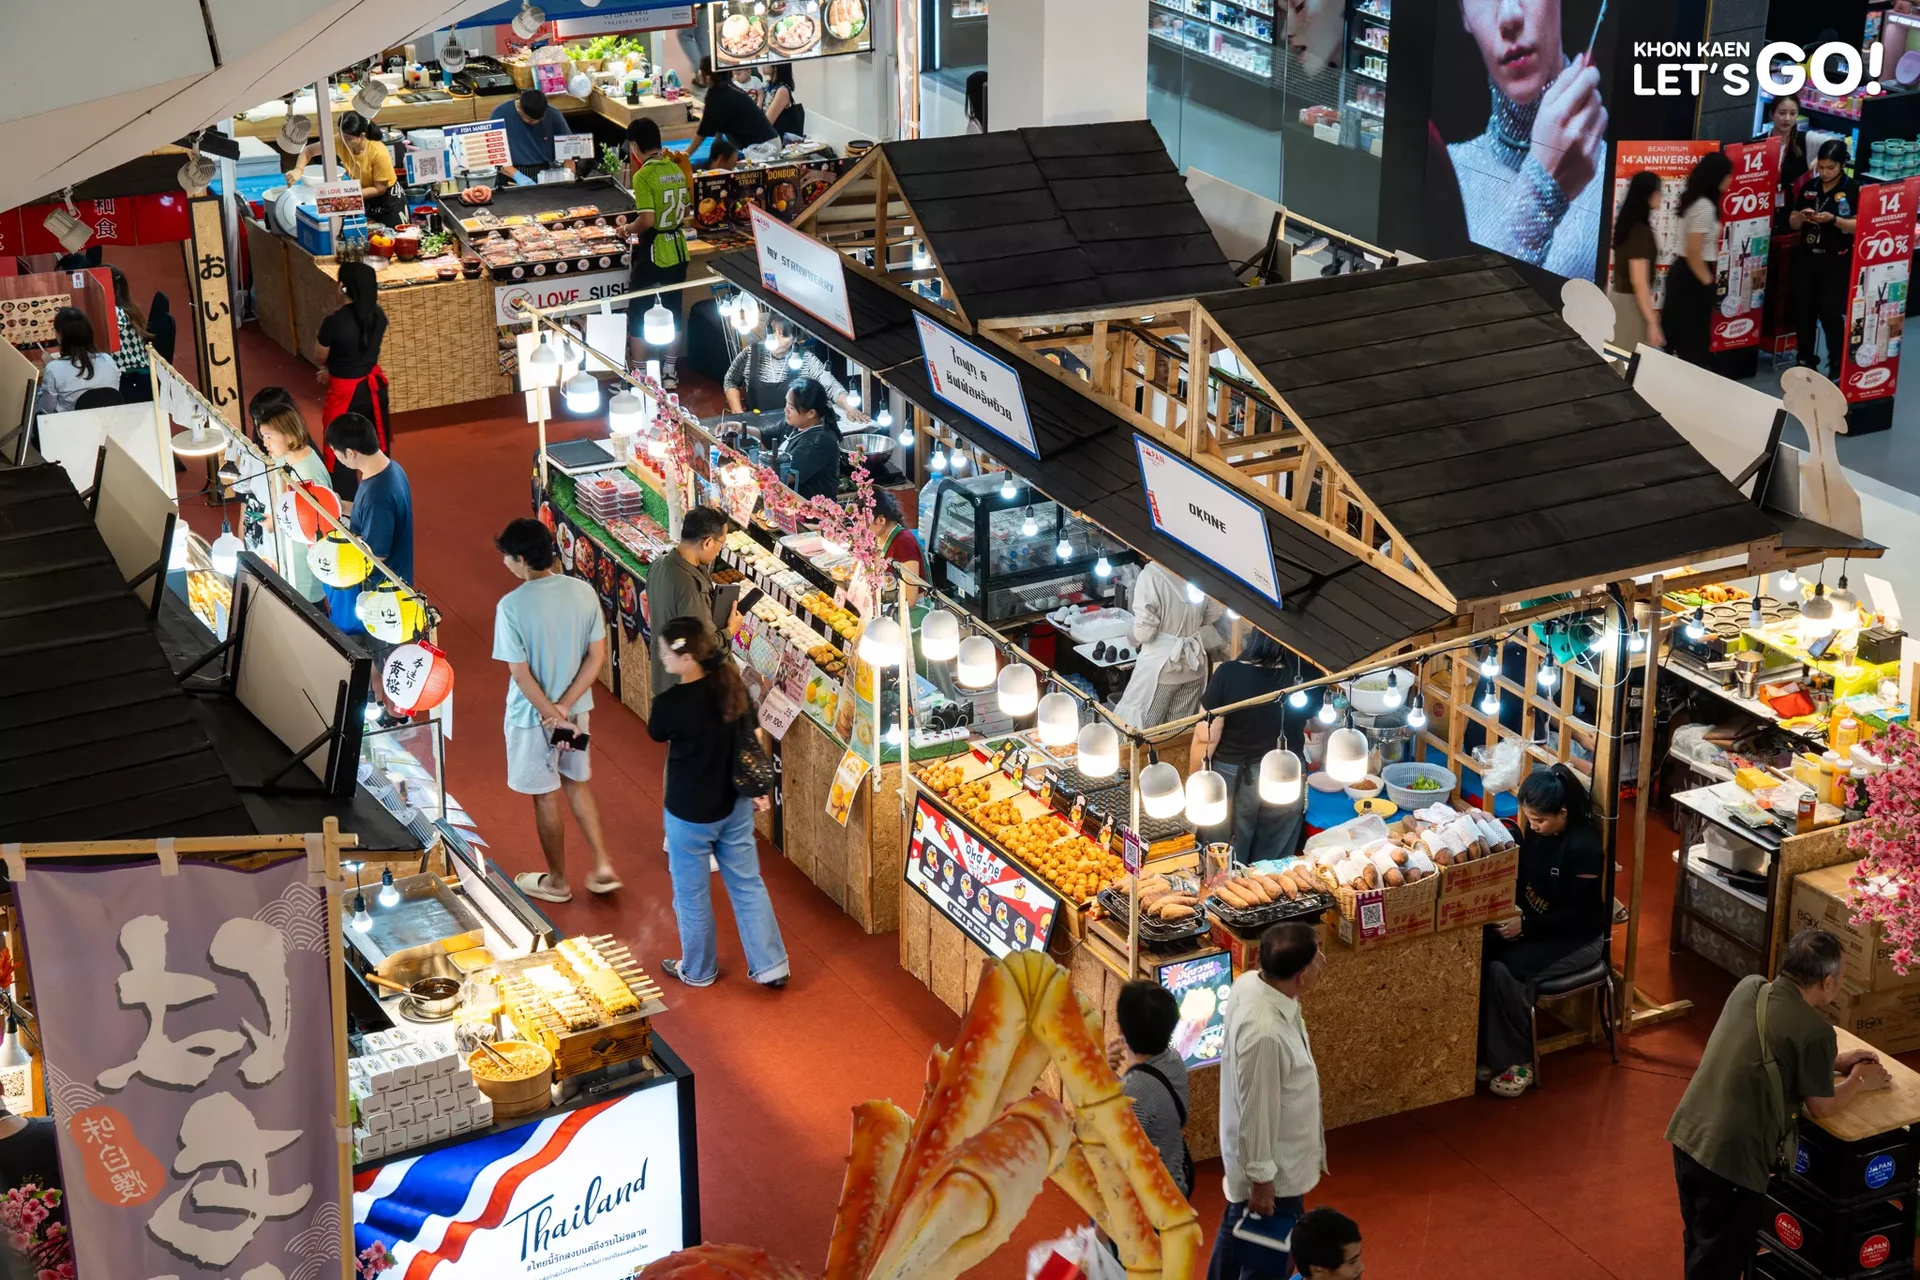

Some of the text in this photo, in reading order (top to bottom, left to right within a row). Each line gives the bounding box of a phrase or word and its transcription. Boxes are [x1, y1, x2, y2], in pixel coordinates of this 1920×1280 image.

[472, 124, 492, 132] MARKET
[1736, 170, 1769, 181] ANNIVERSARY
[1731, 194, 1770, 216] 70%
[94, 198, 118, 239] 和食
[1871, 212, 1907, 223] ANNIVERSARY
[1867, 237, 1909, 260] 70%
[766, 246, 777, 260] MY
[782, 255, 833, 293] STRAWBERRY
[538, 289, 580, 308] LOVE
[199, 254, 238, 407] おいしい
[1142, 446, 1166, 465] JAPAN
[1188, 502, 1226, 534] OKANE
[965, 844, 1000, 880] oka-ne
[1798, 909, 1819, 928] BOX
[1856, 1016, 1884, 1030] BOX
[1868, 1161, 1893, 1173] JAPAN
[503, 1157, 648, 1262] Thailand
[1778, 1218, 1800, 1236] JAPAN
[1863, 1242, 1887, 1252] JAPAN
